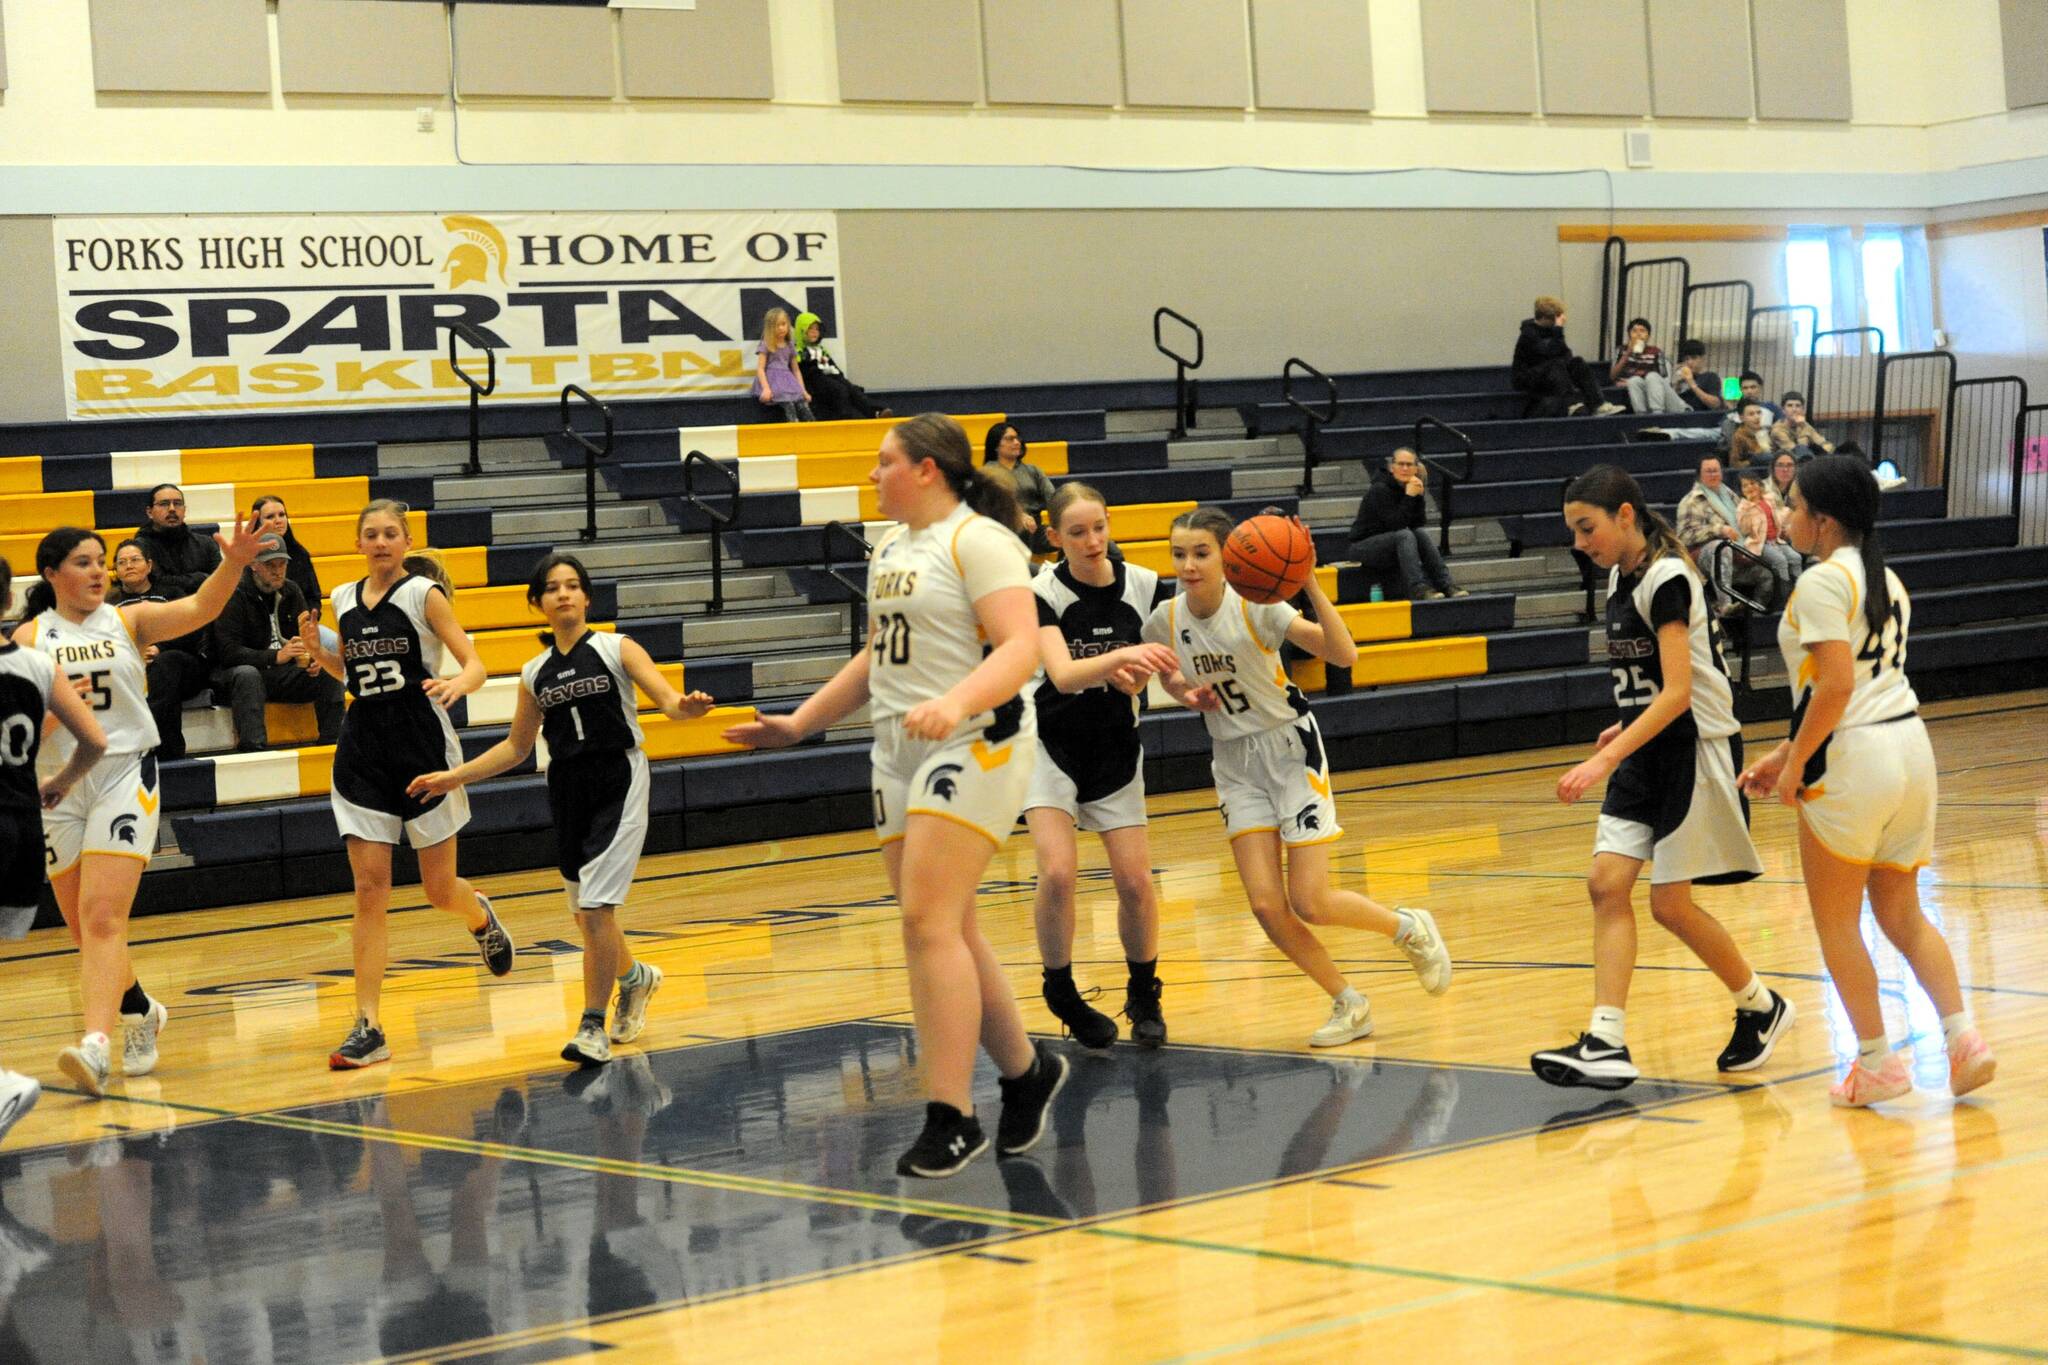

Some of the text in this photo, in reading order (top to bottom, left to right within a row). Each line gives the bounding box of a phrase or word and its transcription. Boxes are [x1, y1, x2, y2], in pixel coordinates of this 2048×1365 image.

[65, 235, 434, 271] FORKS HIGH SCHOOL
[519, 231, 828, 266] HOME OF
[73, 286, 838, 361] SPARTAN
[56, 640, 116, 665] FORKS
[873, 612, 910, 667] 40
[355, 660, 406, 697] 23
[1211, 678, 1252, 716] 15
[1611, 664, 1662, 708] 25
[0, 713, 35, 767] 0
[570, 706, 585, 741] 1
